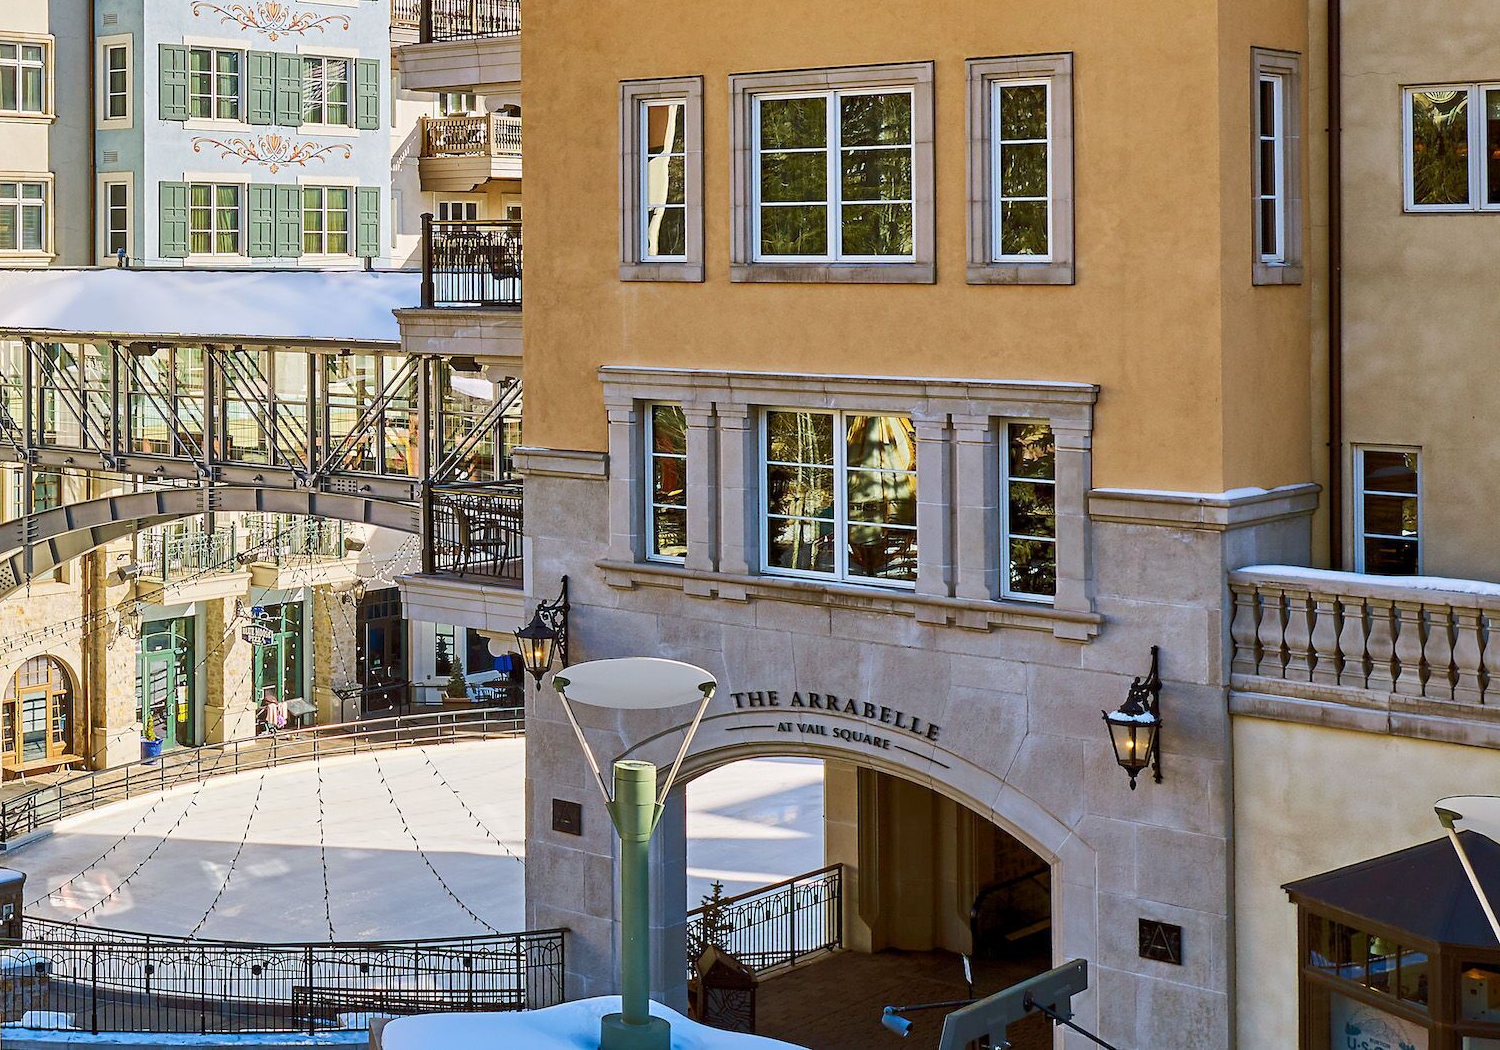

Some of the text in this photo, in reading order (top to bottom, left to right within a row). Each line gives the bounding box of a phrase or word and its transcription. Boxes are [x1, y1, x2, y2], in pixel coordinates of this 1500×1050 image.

[731, 691, 940, 741] THE ARRABELLE
[777, 722, 891, 750] AT VAIL SQUARE
